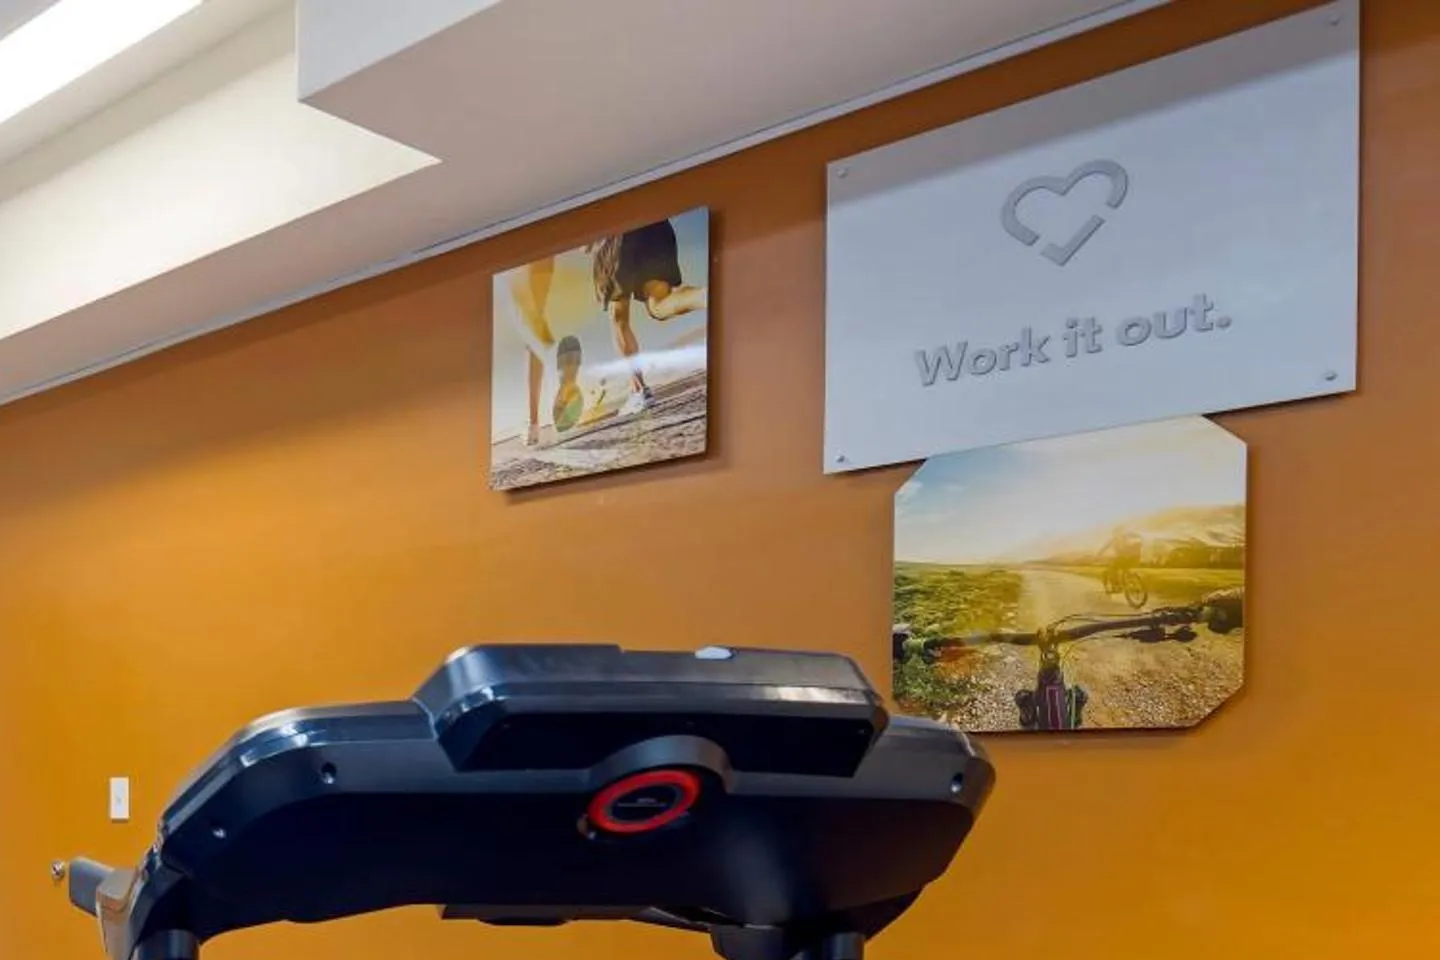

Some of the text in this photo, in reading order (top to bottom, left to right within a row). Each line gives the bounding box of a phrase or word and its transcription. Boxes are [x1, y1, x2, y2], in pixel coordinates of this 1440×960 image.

[914, 293, 1234, 388] Work it out.
